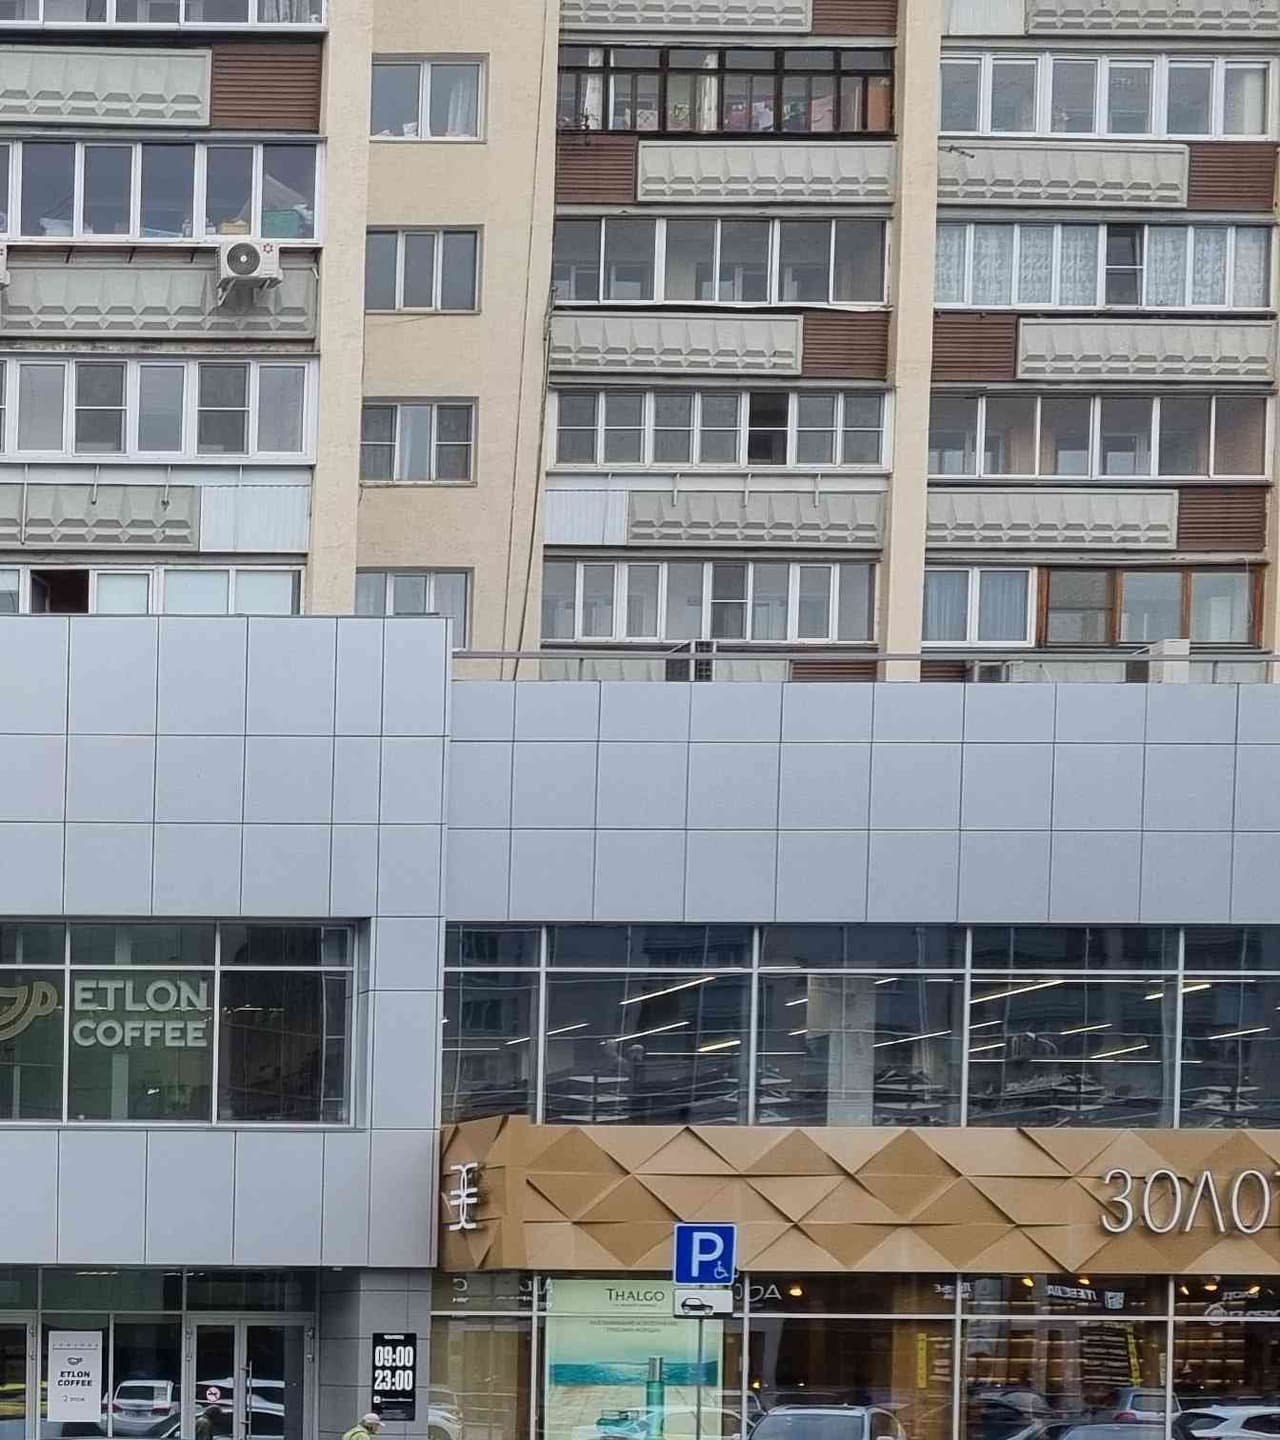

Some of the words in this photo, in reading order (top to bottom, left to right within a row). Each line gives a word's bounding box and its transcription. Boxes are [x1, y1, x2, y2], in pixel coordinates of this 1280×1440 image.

[74, 979, 208, 1011] ETLON
[72, 1019, 208, 1047] COFFEE
[1100, 1168, 1280, 1234] ЗОЛО
[374, 1346, 414, 1367] 09:00
[57, 1379, 93, 1387] COFFEE
[59, 1370, 91, 1378] ETLON
[373, 1369, 413, 1391] 23:00
